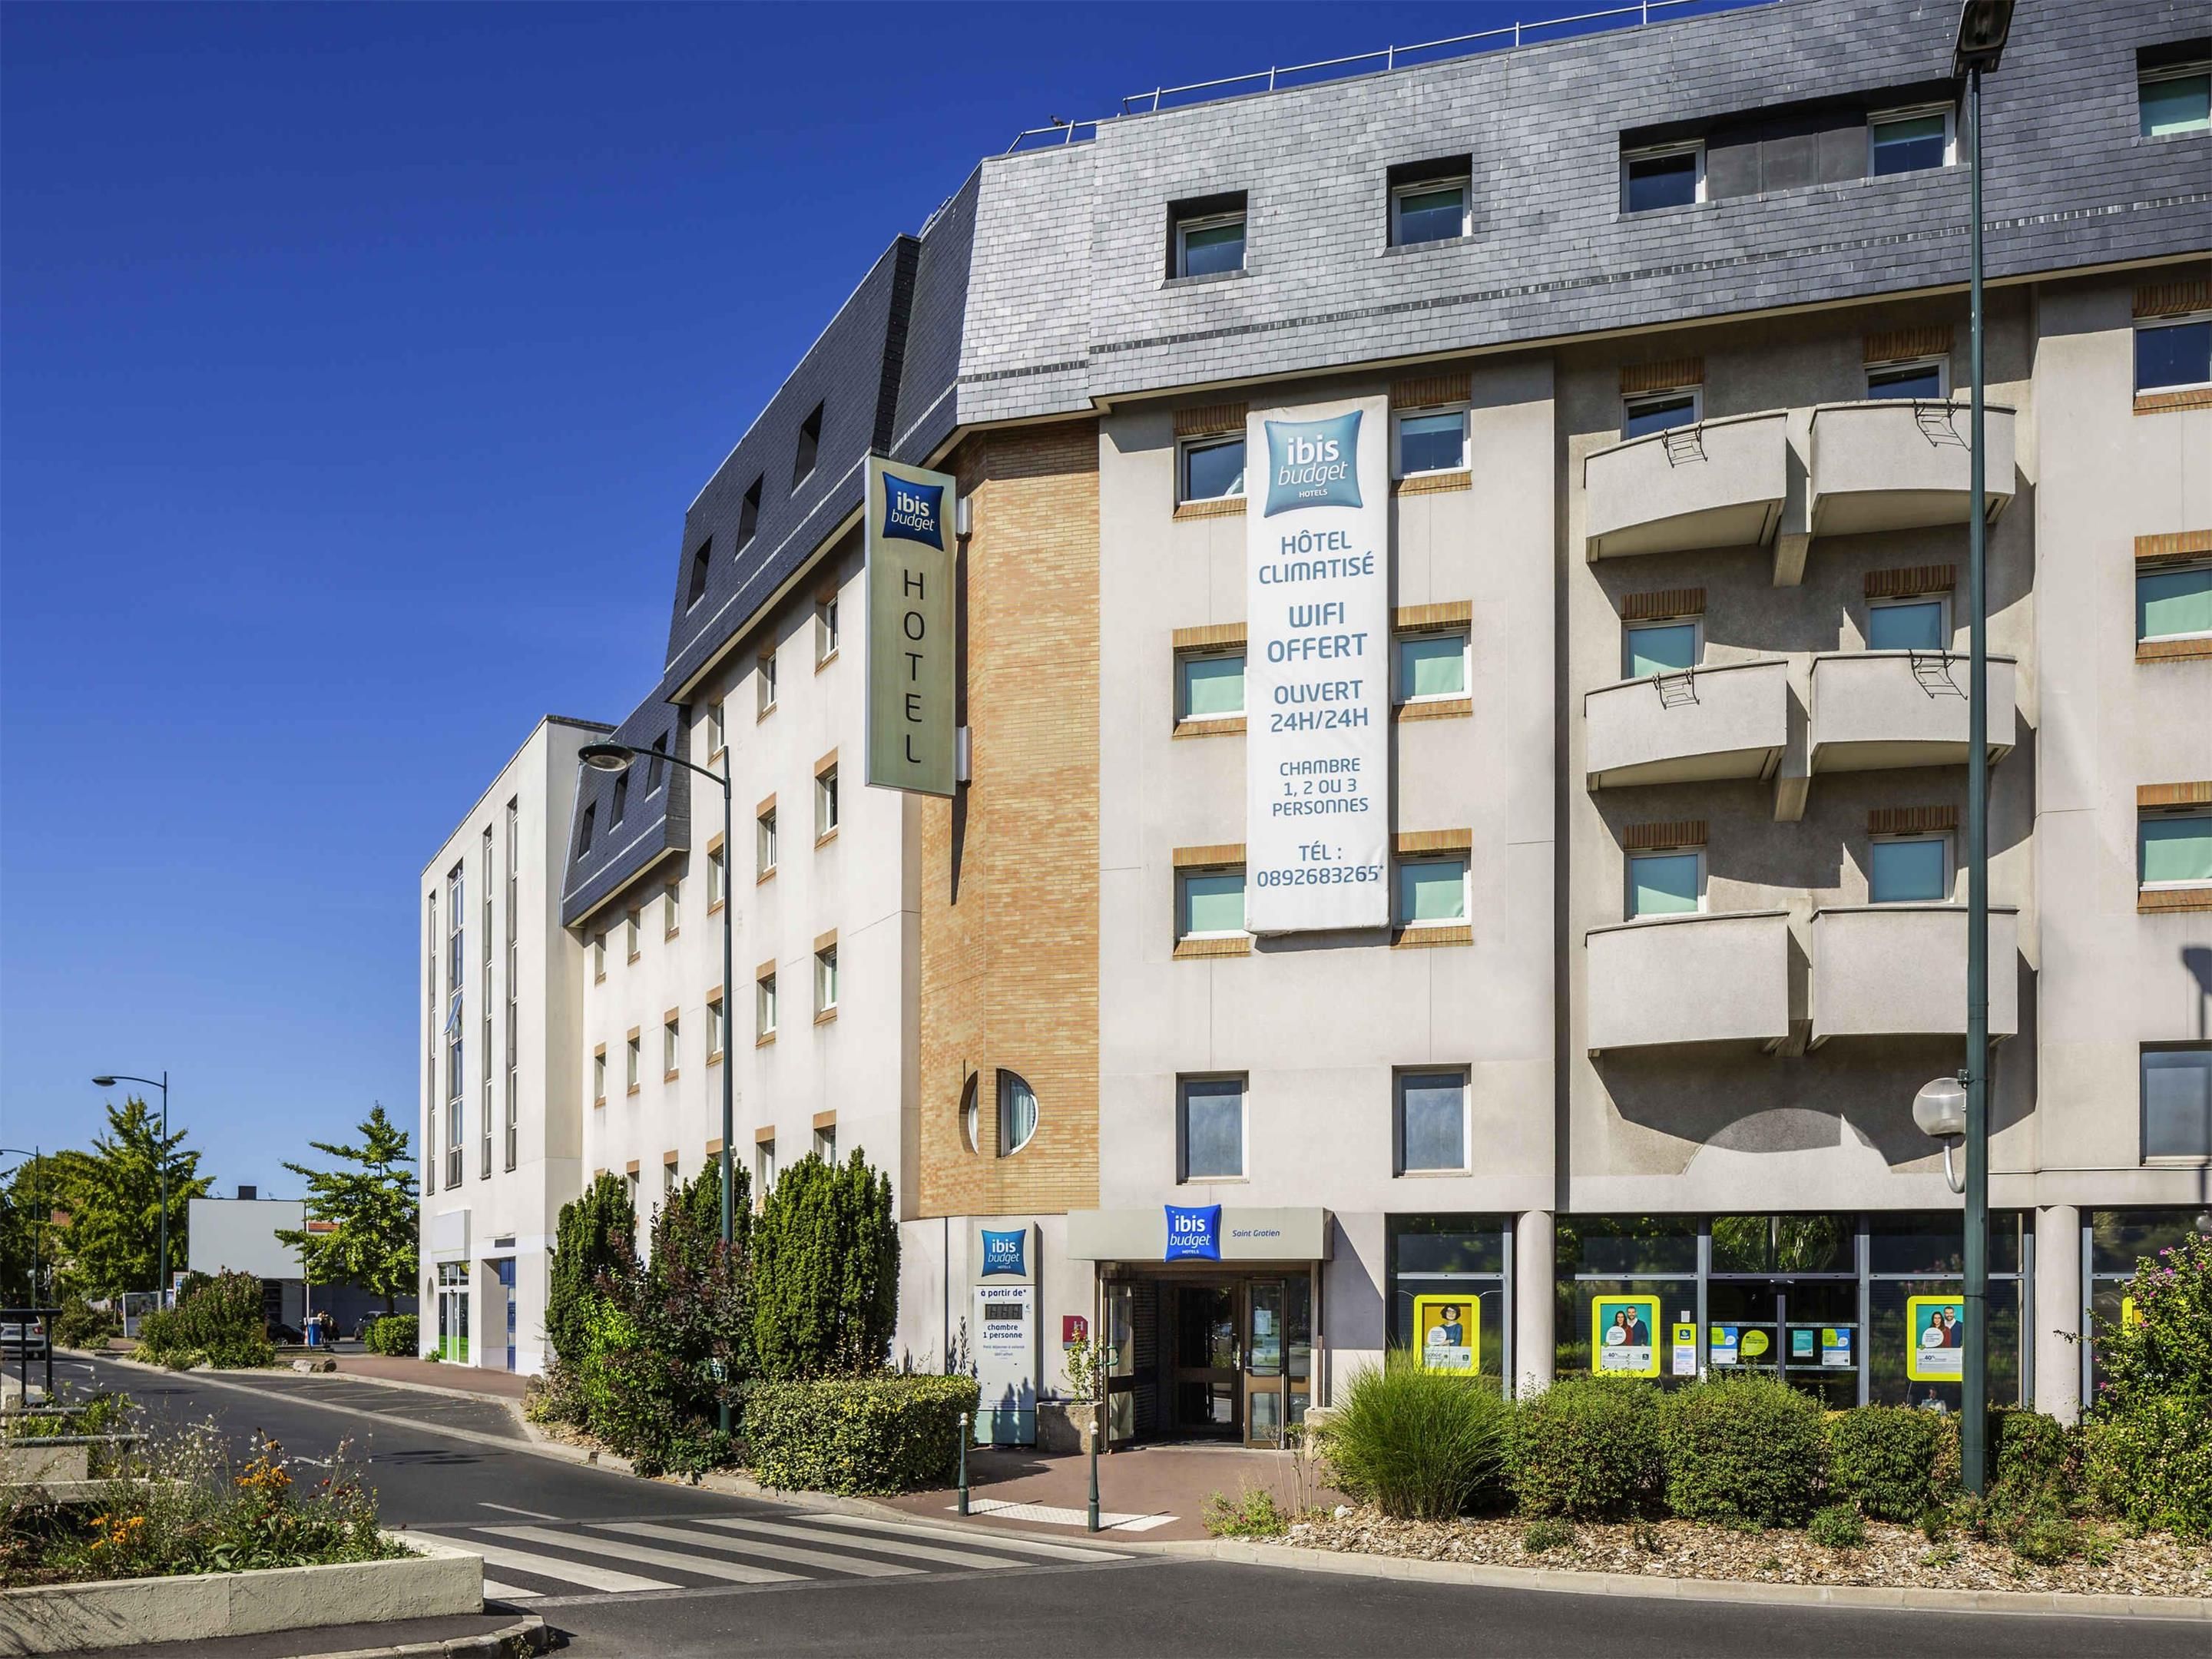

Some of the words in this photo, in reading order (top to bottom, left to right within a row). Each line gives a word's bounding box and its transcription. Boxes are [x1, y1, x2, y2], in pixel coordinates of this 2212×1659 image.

[1287, 434, 1339, 465] ibis
[1278, 461, 1348, 486] budget
[1299, 488, 1328, 498] HOTELS
[896, 492, 929, 517] ibis
[891, 508, 935, 531] budget
[1281, 529, 1352, 555] HÔTEL
[1259, 551, 1374, 584] CLIMATISÉ
[1289, 601, 1344, 628] WIFI
[1267, 632, 1368, 664] OFFERT
[902, 568, 926, 764] HOTEL
[1273, 680, 1363, 705] OUVERT
[1270, 707, 1369, 733] 24H/24H
[1280, 757, 1361, 777] CHAMBRE
[1283, 782, 1297, 798] 1,
[1303, 780, 1313, 795] 2
[1318, 778, 1342, 794] OU
[1346, 778, 1357, 793] 3
[1272, 797, 1369, 817] PERSONNES
[1298, 840, 1332, 862] TÉL
[1174, 1215, 1206, 1233] ibis
[992, 1238, 1017, 1253] ibis
[1170, 1233, 1211, 1249] budget
[988, 1252, 1020, 1265] budget
[988, 1289, 1011, 1298] partir
[989, 1332, 1023, 1340] personne
